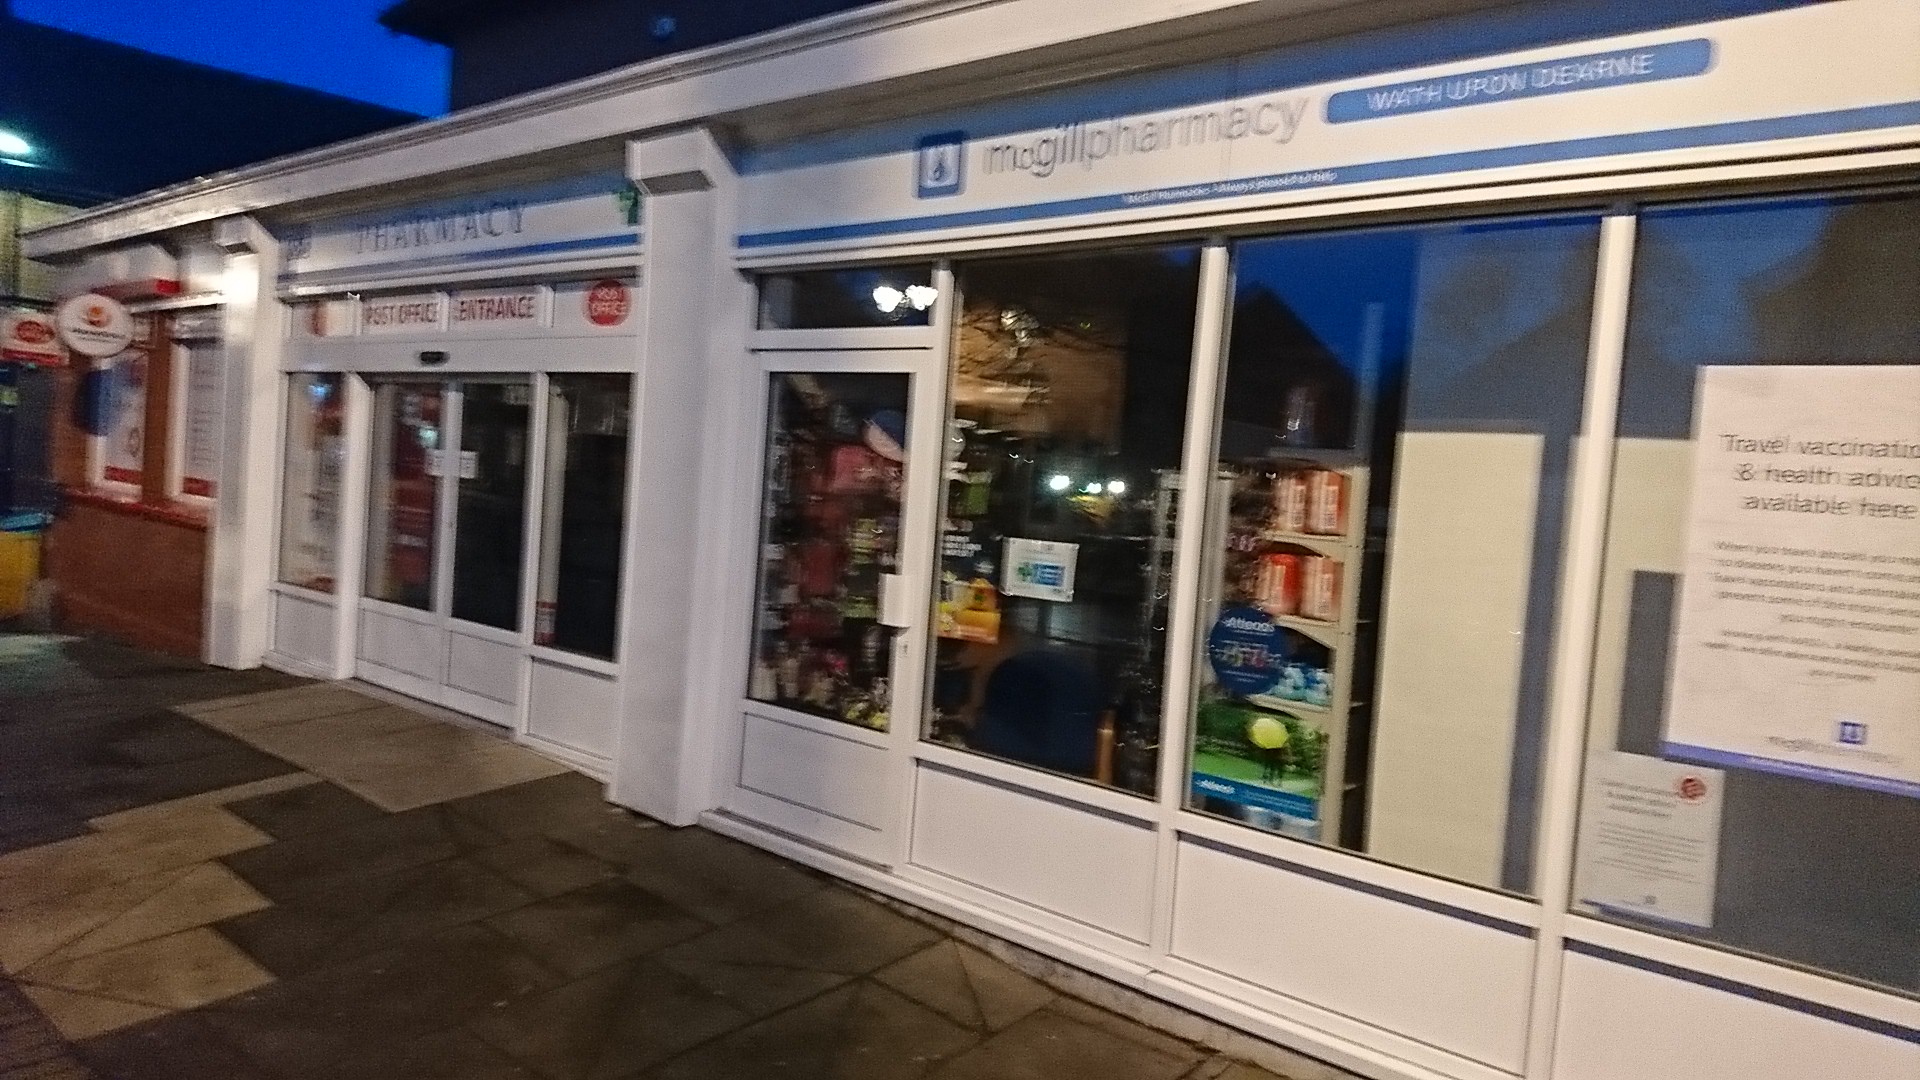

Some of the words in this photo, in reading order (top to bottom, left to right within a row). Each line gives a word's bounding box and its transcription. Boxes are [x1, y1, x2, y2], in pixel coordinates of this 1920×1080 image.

[1366, 83, 1442, 112] WATH
[1446, 72, 1527, 101] UPON
[1531, 54, 1655, 88] DEARNE
[358, 208, 524, 254] PHARMACY
[366, 305, 395, 325] POST
[399, 302, 439, 324] OFFICE
[455, 295, 536, 321] ENTRANCE
[1719, 434, 1790, 454] Travel
[1737, 463, 1754, 481] &
[1766, 464, 1841, 485] health
[1741, 494, 1850, 515] available
